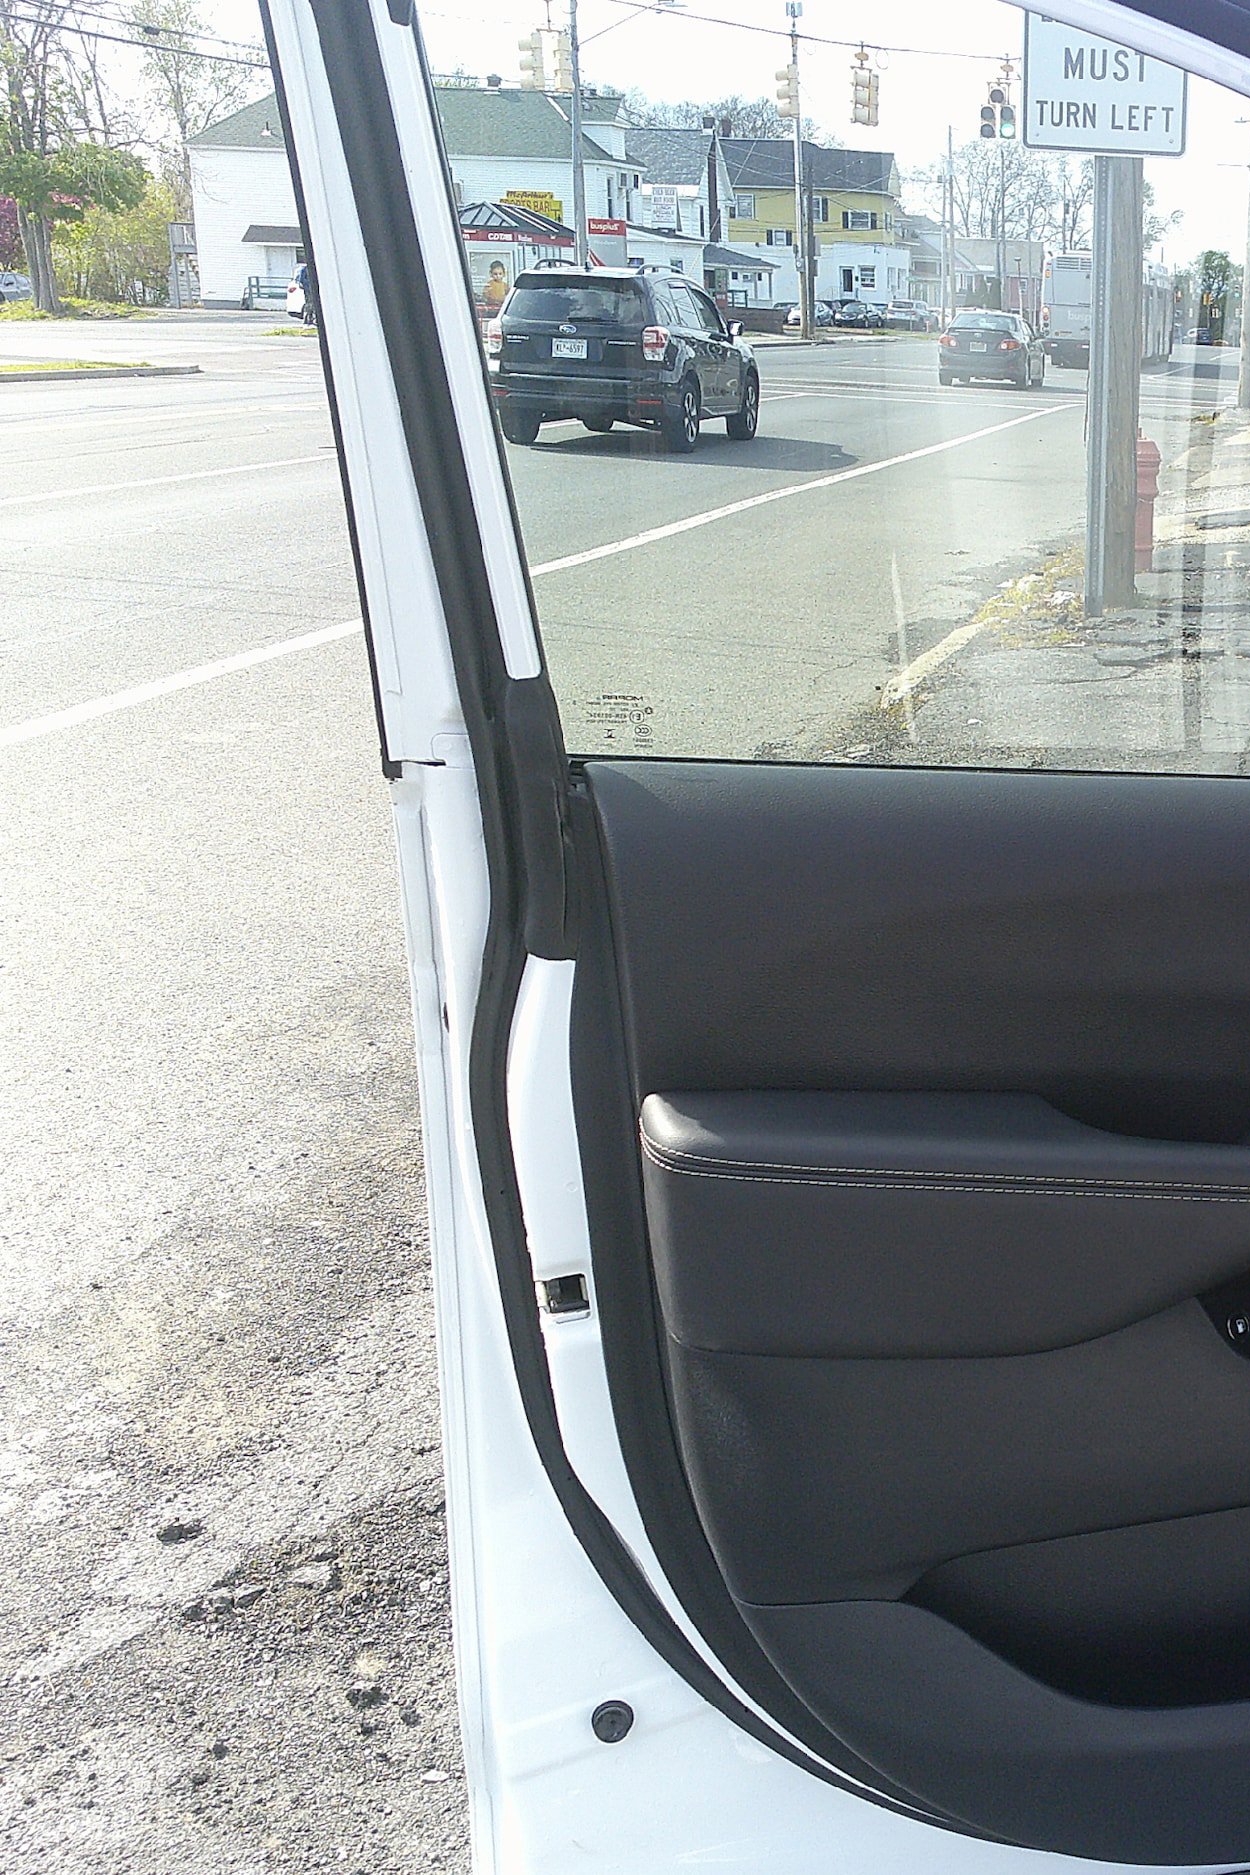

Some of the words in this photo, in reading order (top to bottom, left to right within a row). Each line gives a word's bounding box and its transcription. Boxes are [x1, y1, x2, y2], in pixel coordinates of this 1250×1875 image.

[1063, 47, 1145, 82] MUST
[1035, 100, 1097, 129] TURN
[1111, 104, 1174, 133] LEFT
[533, 201, 550, 212] BAR
